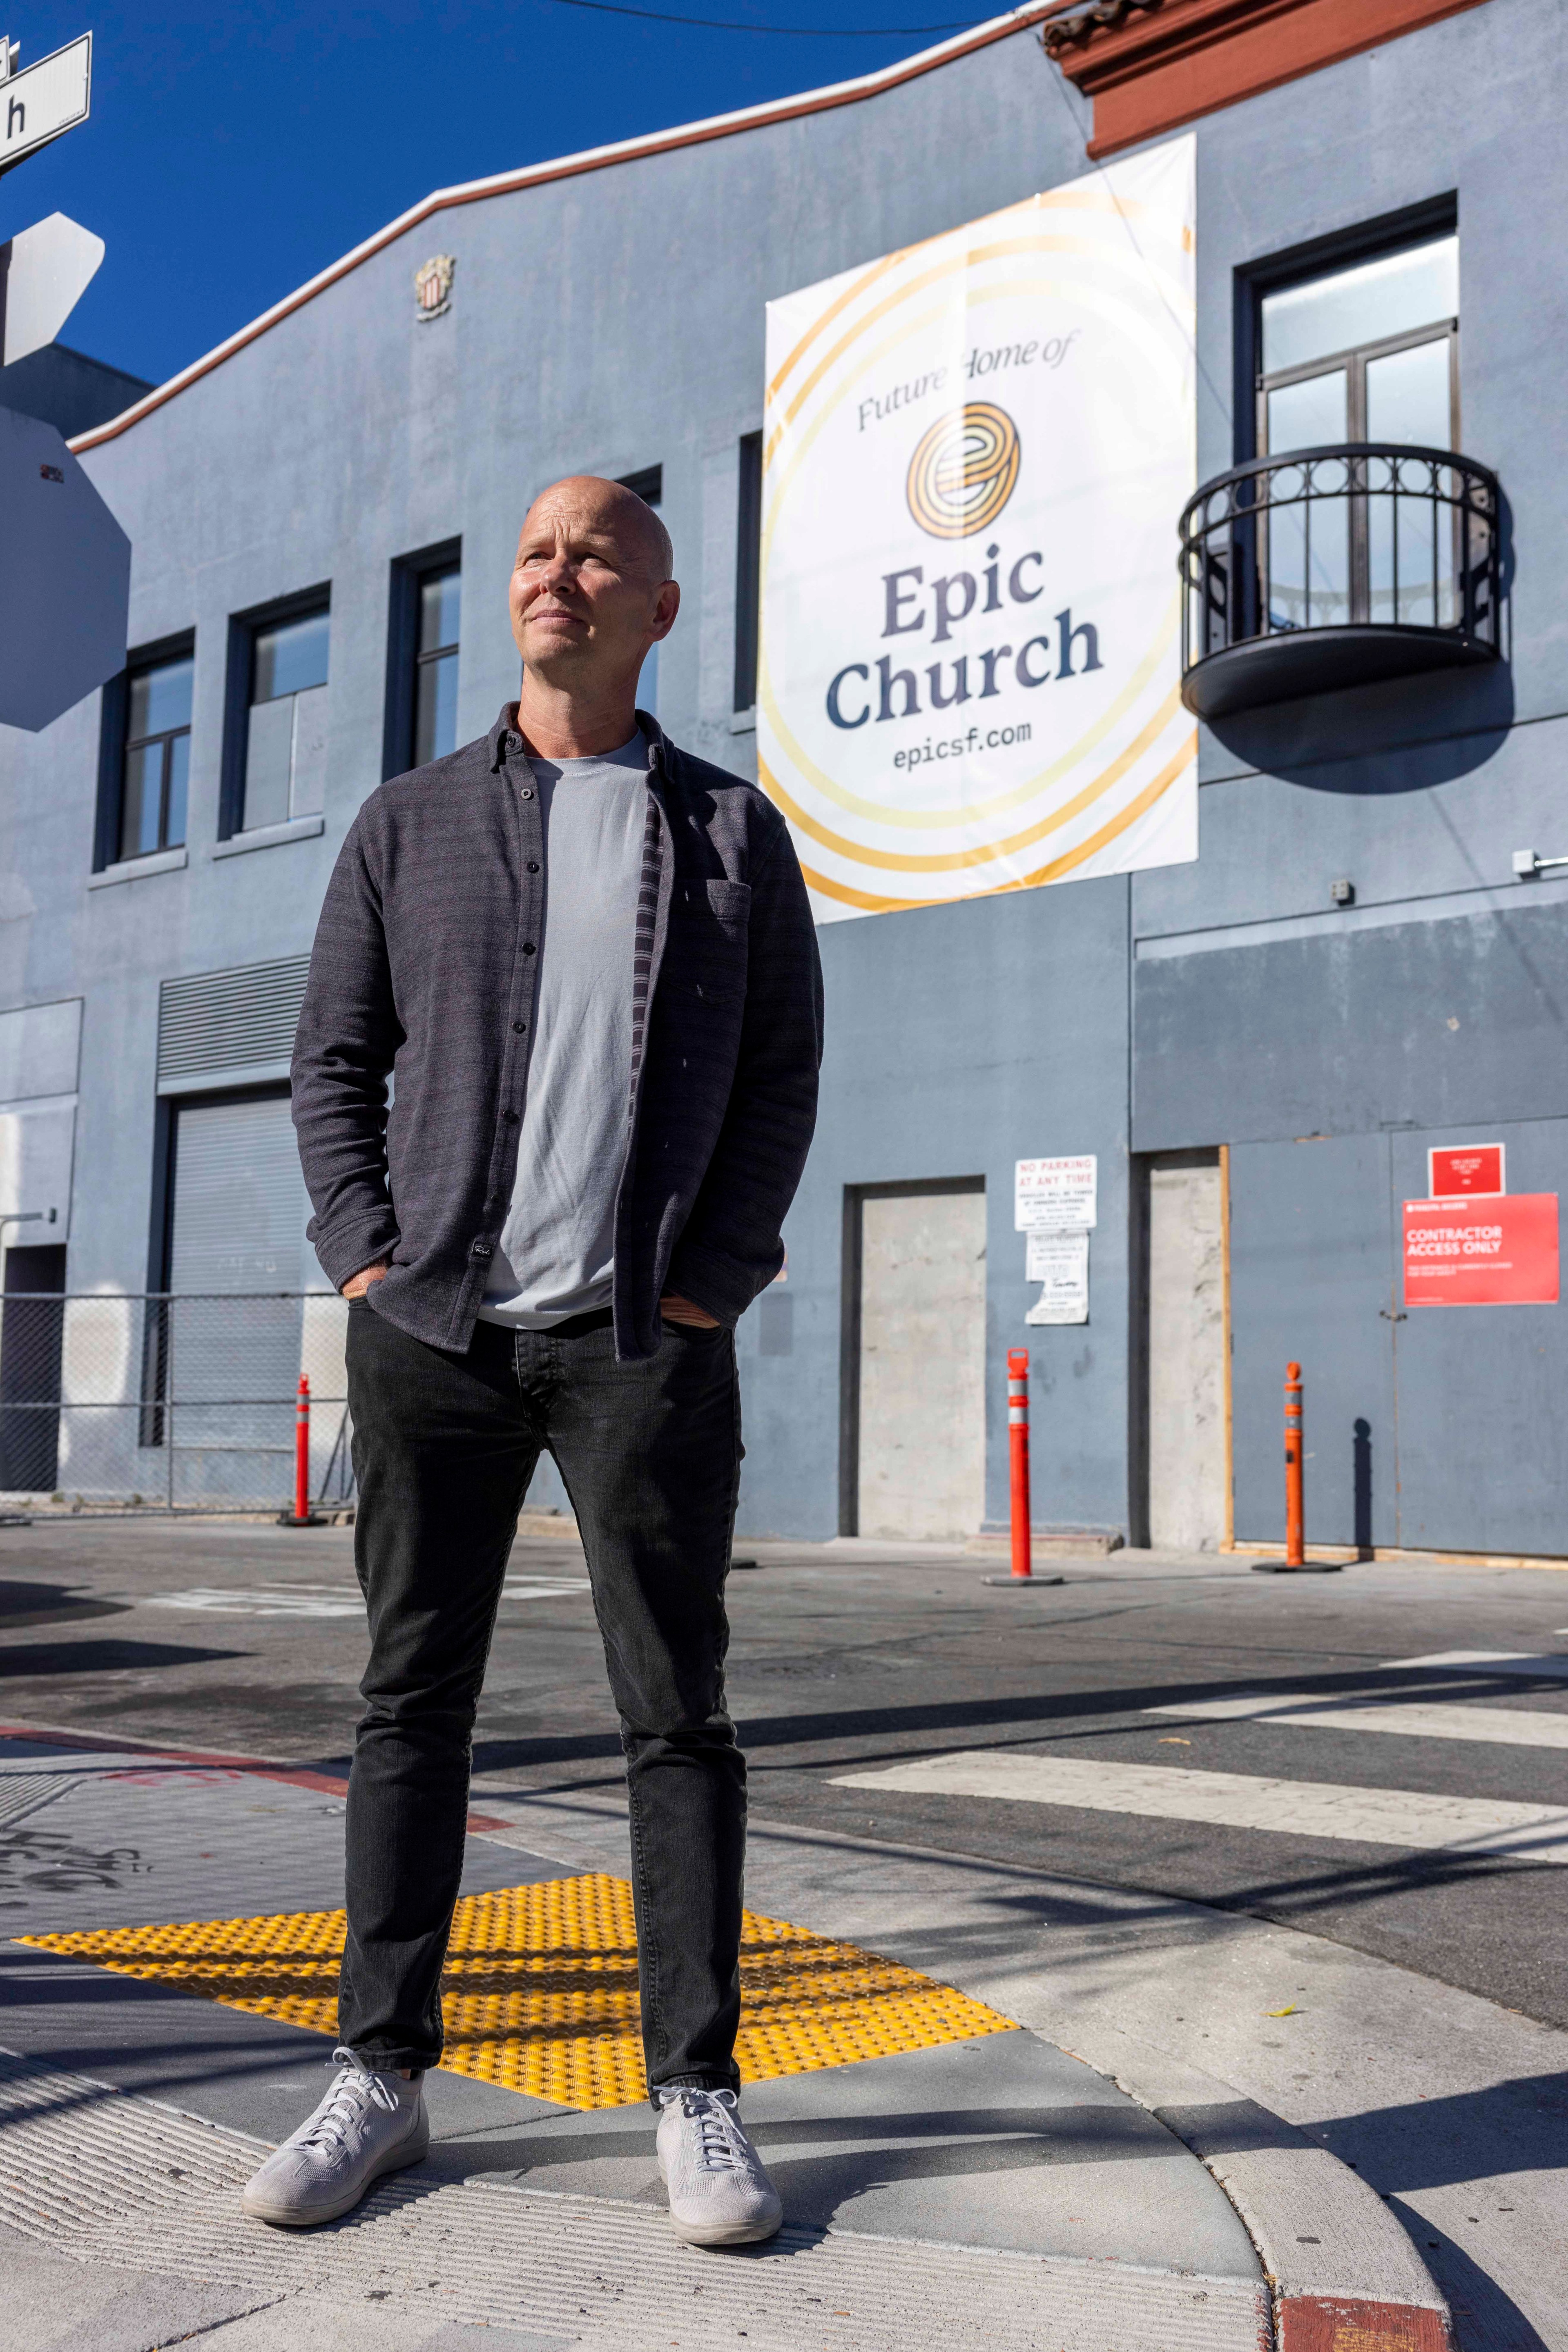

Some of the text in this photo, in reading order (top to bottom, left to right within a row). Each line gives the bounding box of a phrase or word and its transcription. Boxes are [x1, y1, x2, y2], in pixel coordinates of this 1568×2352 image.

[857, 328, 1081, 431] Future Home of
[880, 543, 1044, 643] Epic
[826, 608, 1104, 730] Church
[893, 722, 1032, 772] epicsf.com
[1020, 1159, 1092, 1172] NO PARKING
[1020, 1174, 1092, 1186] AT ANY TIME
[1407, 1226, 1502, 1243] CONTRACTOR
[475, 1246, 490, 1255] Rails
[1407, 1241, 1502, 1256] ACCESS ONLY
